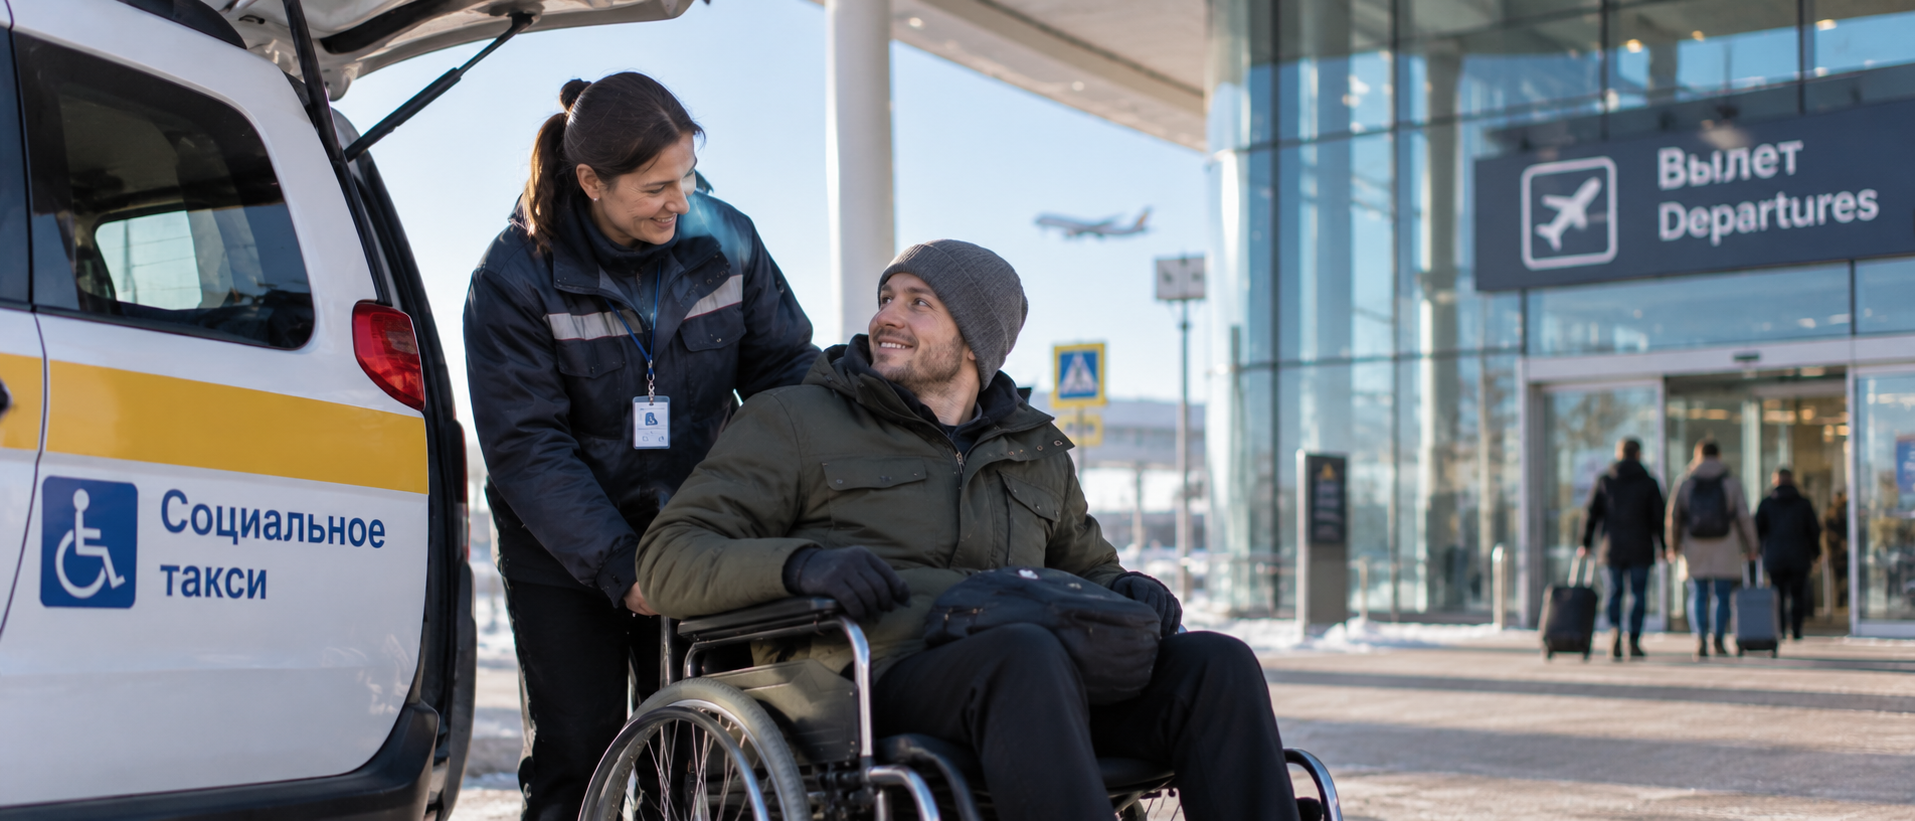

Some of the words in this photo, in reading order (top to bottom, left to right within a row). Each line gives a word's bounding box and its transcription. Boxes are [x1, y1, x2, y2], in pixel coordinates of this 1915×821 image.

[1658, 140, 1803, 189] Вылет
[1658, 188, 1879, 246] Departures
[161, 488, 386, 549] Социальное
[160, 564, 267, 600] такси
